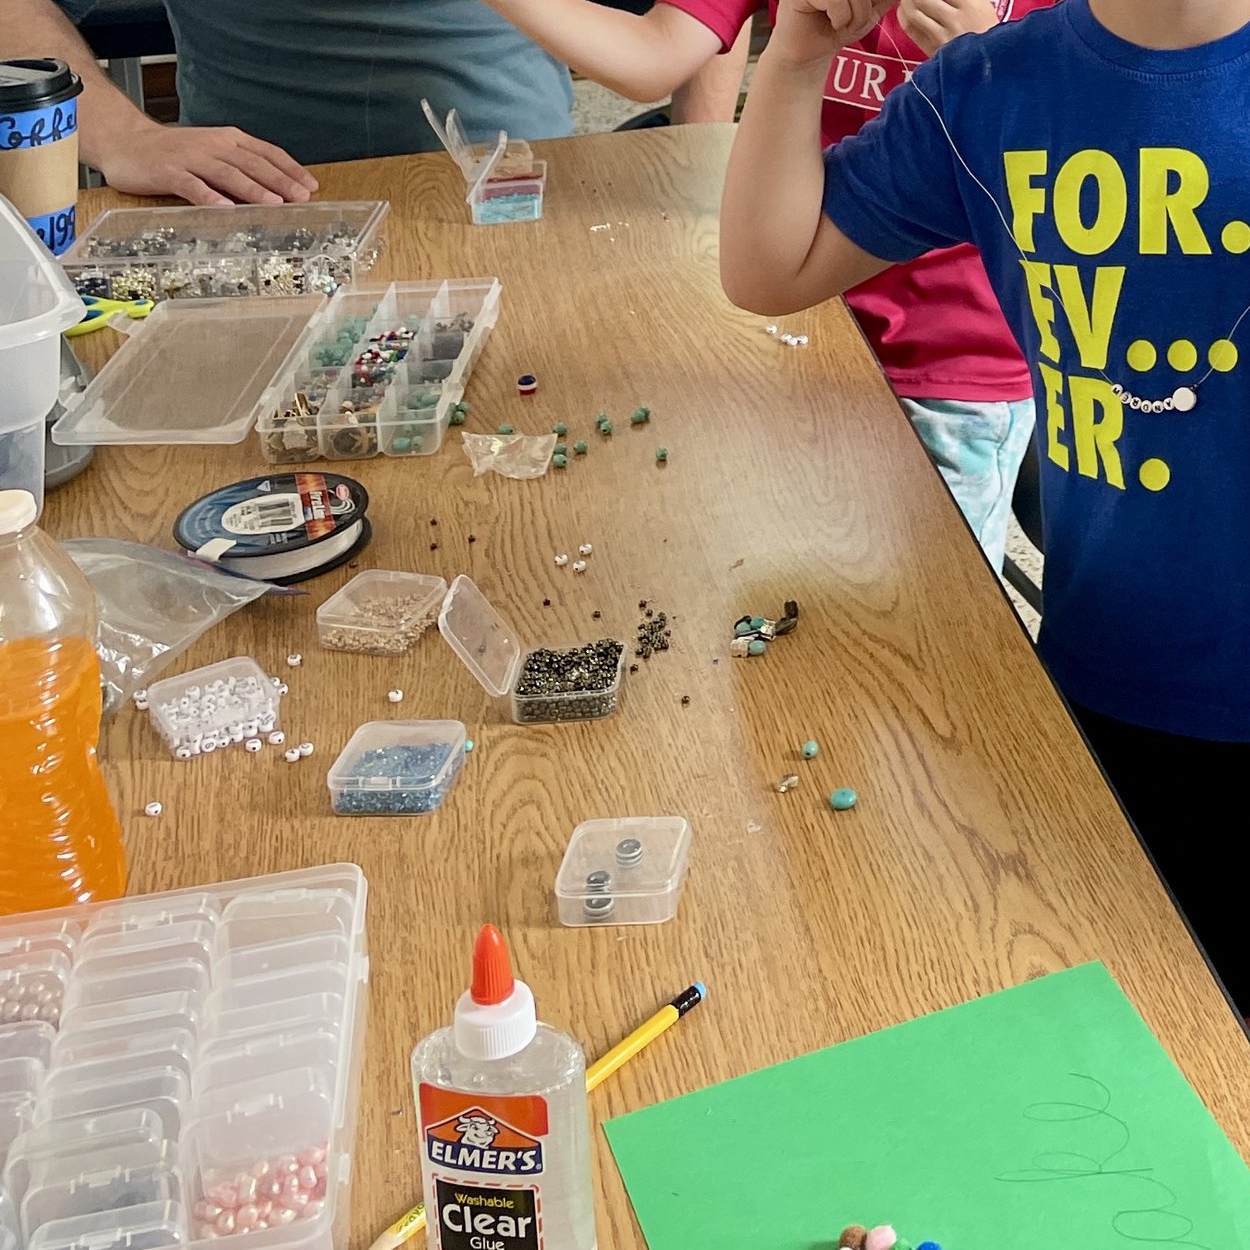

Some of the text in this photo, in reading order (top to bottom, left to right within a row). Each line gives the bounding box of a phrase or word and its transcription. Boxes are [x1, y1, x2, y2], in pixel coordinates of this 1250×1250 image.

[1019, 260, 1238, 372] EV...
[1038, 361, 1171, 491] ER.
[431, 1141, 538, 1171] ELMER'S
[454, 1192, 515, 1209] Washable
[441, 1203, 532, 1239] Clear
[469, 1236, 505, 1250] Glue
